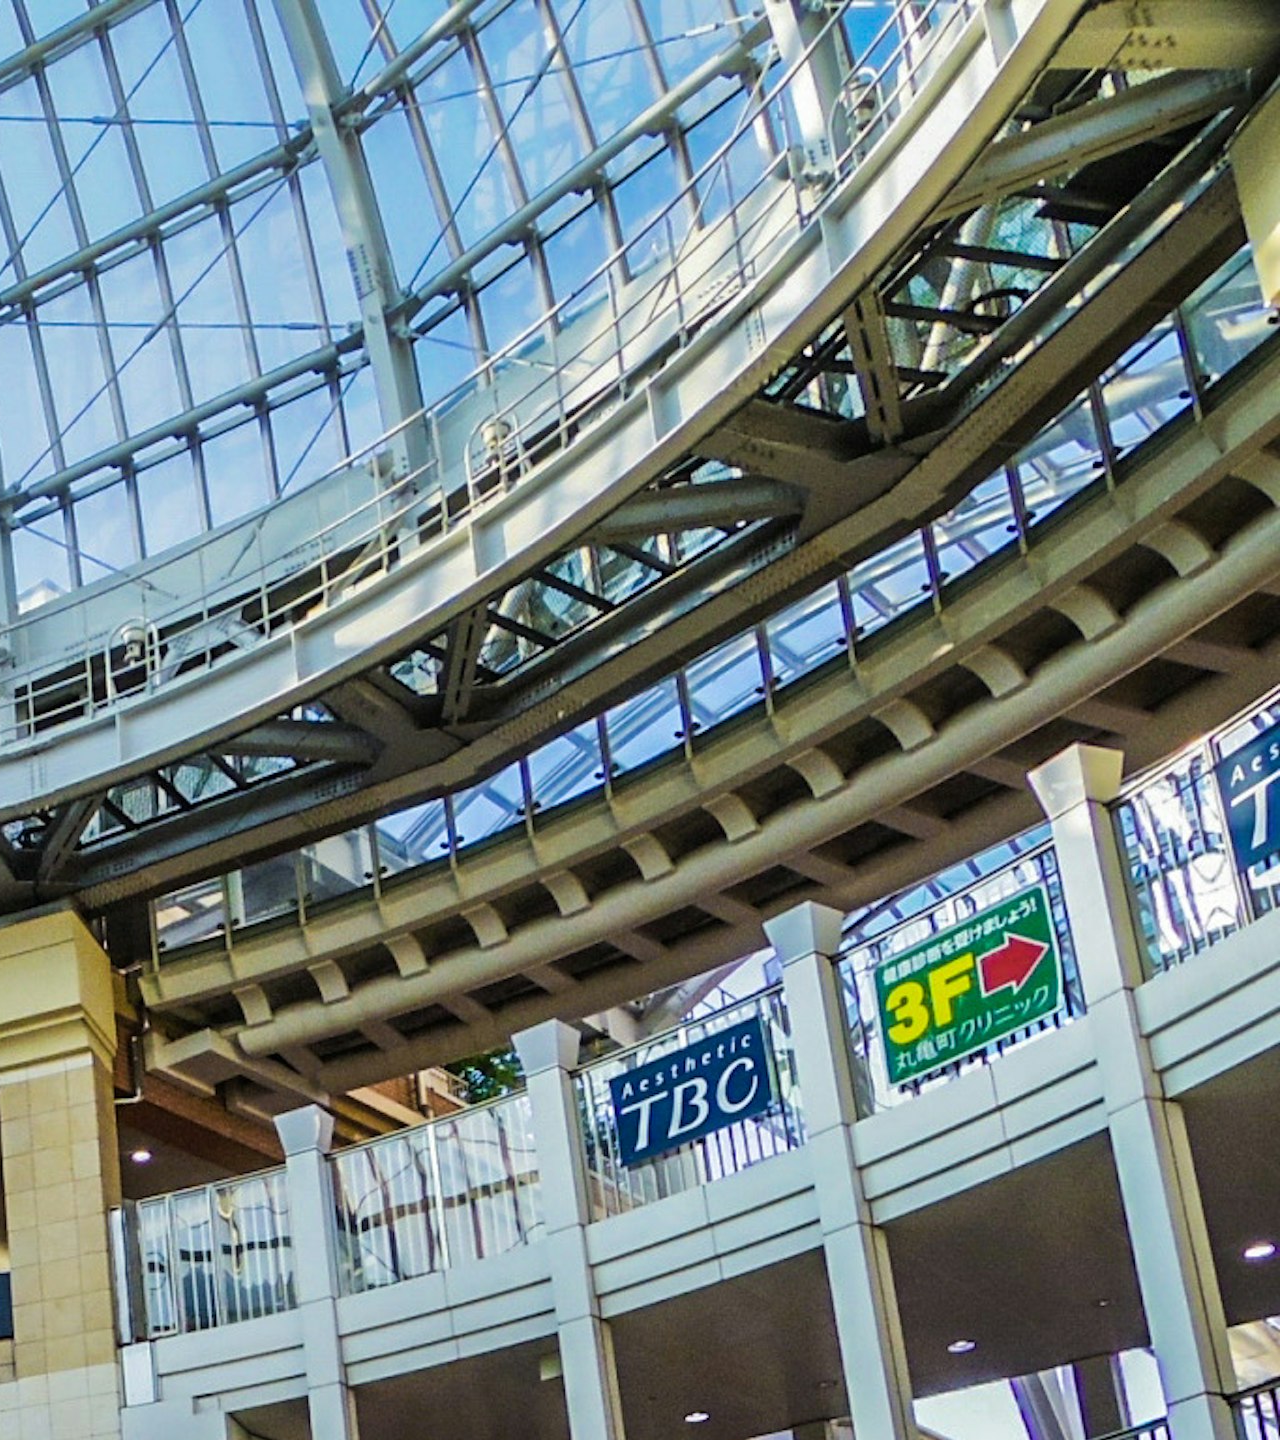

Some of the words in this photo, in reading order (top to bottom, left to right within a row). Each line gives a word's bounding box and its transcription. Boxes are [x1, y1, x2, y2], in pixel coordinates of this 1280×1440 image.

[886, 952, 974, 1045] 3F
[896, 985, 1049, 1072] 丸亀町クリニック
[621, 1057, 758, 1152] TBC
[622, 1034, 752, 1100] Aesthetic
